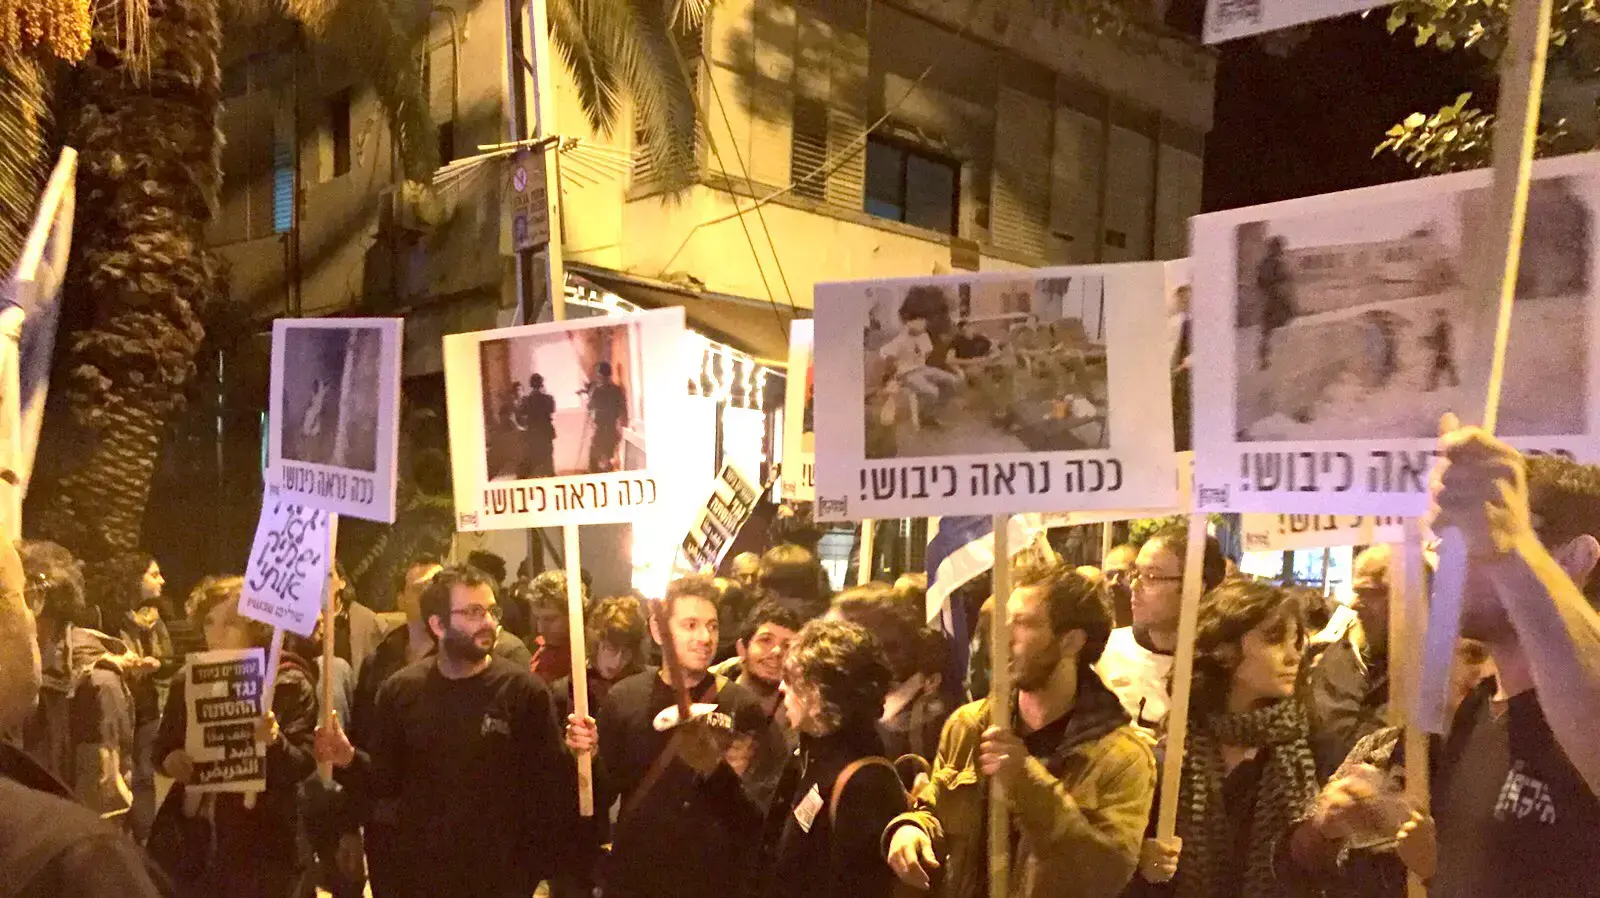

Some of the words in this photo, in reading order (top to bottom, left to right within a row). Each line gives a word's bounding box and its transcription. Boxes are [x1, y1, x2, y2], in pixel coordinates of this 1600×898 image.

[282, 465, 315, 494] כיבוש!
[317, 470, 348, 500] נראה
[859, 464, 957, 500] כיבוש!
[970, 460, 1050, 496] נראה
[1065, 458, 1123, 493] ככה
[1241, 451, 1354, 492] כיבוש!
[351, 475, 374, 504] ככה
[484, 486, 547, 515] כיבוש!
[555, 481, 608, 511] נראה
[618, 479, 657, 506] ככה
[249, 561, 304, 601] אותי
[232, 680, 257, 698] נגד
